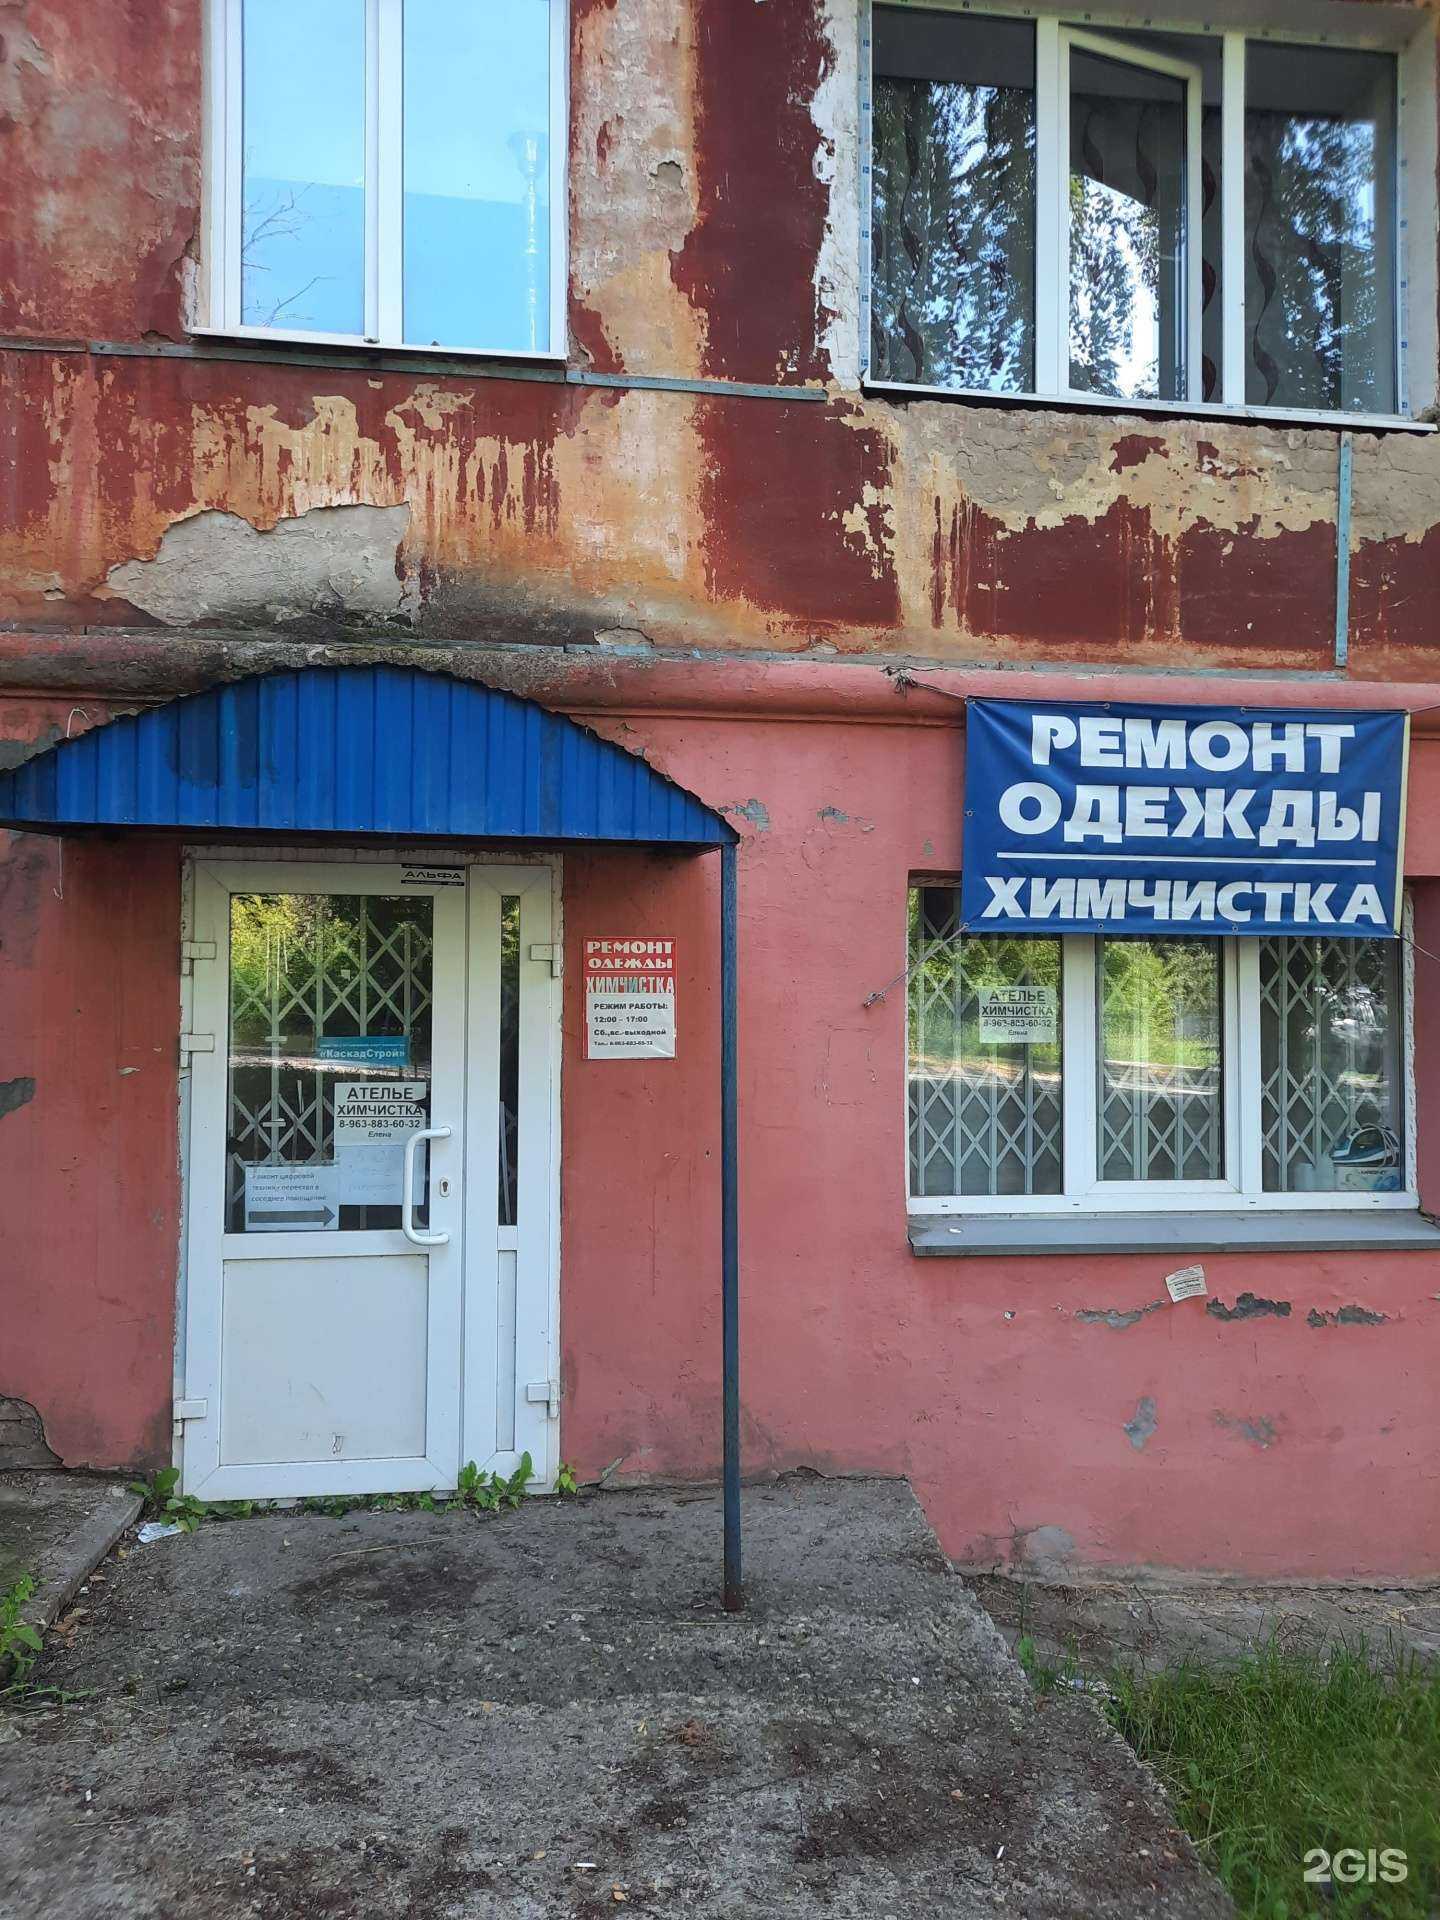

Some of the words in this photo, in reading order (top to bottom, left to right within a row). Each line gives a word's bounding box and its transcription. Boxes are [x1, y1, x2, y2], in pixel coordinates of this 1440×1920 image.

[1031, 714, 1355, 773] РЕМОНТ
[998, 782, 1381, 848] ОДЕЖДЫ
[404, 871, 461, 880] АЛЬФА
[980, 876, 1387, 925] ХИМЧИСТКА
[587, 941, 673, 954] РЕМОНТ
[588, 958, 673, 969] ОДЕЖДЫ
[586, 976, 674, 993] ХИМЧИСТКА
[989, 990, 1046, 1002] АТЕЛЬЕ
[629, 1002, 668, 1010] РАБОТЫ:
[982, 1006, 1054, 1016] ХИМЧИСТКА
[626, 1015, 648, 1023] 17:00
[347, 1087, 414, 1100] АТЕЛЬЕ
[337, 1104, 423, 1116] ХИМЧИСТКА
[339, 1119, 421, 1129] 8-963-883-60-32
[367, 1130, 392, 1138] Елена
